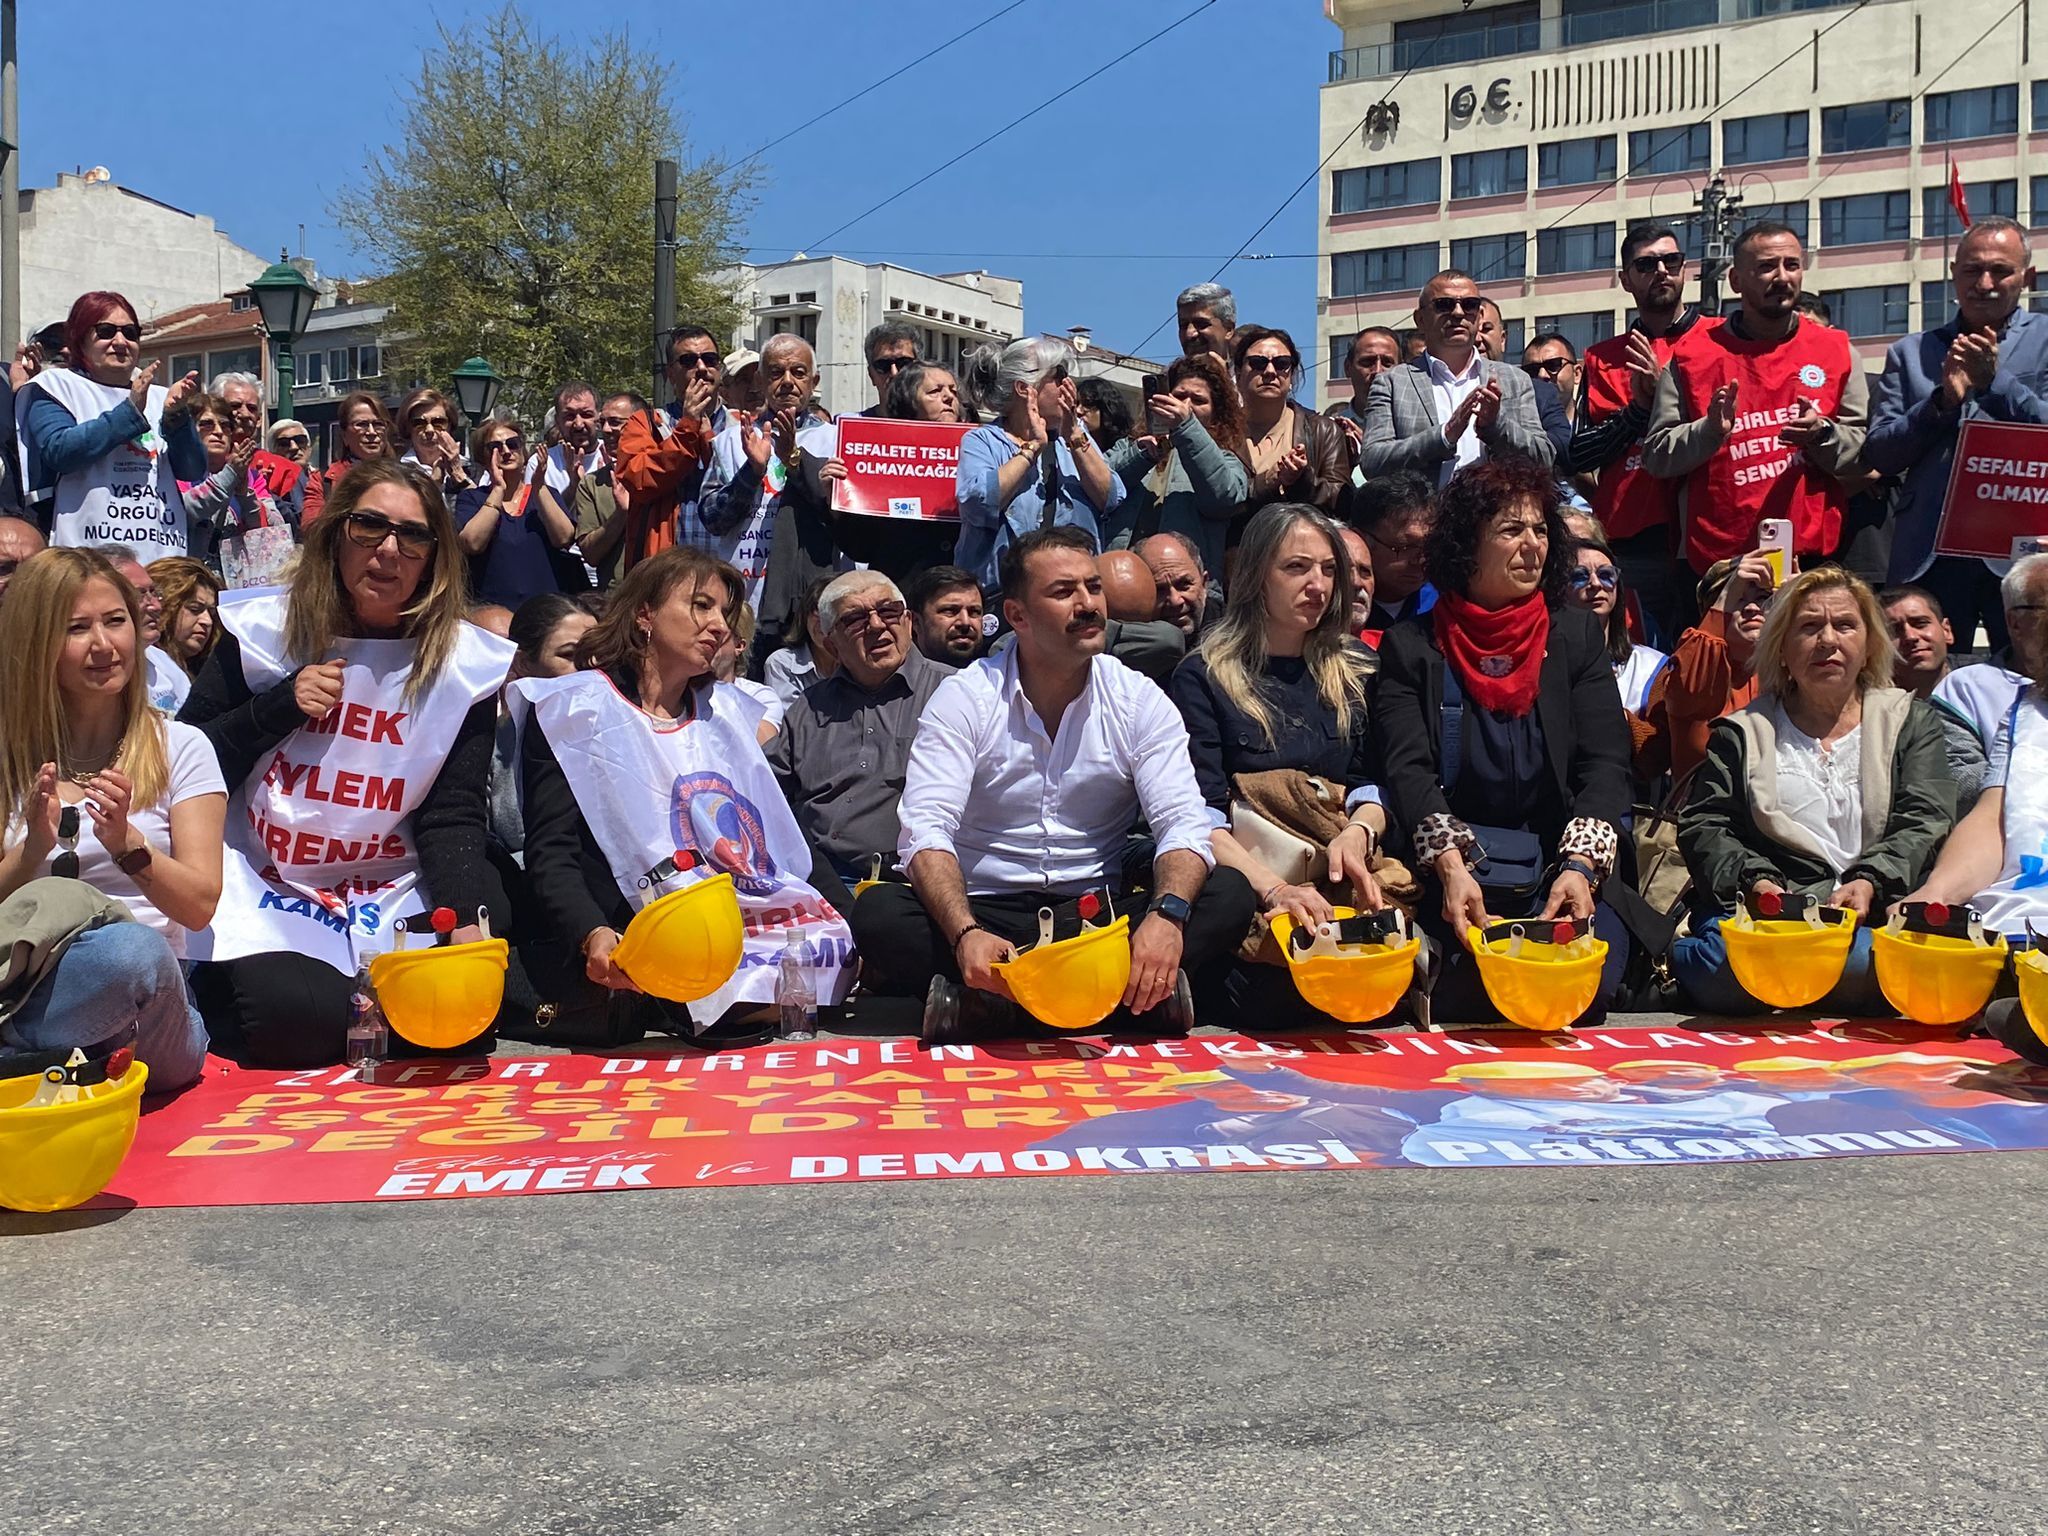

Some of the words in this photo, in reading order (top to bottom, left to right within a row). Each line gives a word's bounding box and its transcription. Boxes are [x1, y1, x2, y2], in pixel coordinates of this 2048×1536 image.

[845, 443, 917, 459] SEFALETE
[920, 446, 959, 460] TESLİ
[1729, 434, 1788, 461] META
[856, 462, 958, 479] OLMAYACAĞIZ
[1733, 451, 1806, 487] SENDİK
[1966, 456, 2048, 479] SEFALET
[1977, 483, 2048, 504] OLMAYA
[306, 702, 408, 745] MEK
[236, 1077, 699, 1108] DORUK
[747, 1061, 1190, 1089] MADEN
[274, 1061, 550, 1087] ZAFER
[201, 1092, 666, 1131] İŞÇİSİ
[711, 1080, 1187, 1108] YALNIZ
[375, 1163, 656, 1197] EMEK
[790, 1139, 1362, 1179] DEMOKRASİ
[1427, 1129, 1963, 1162] Platformu
[394, 1150, 673, 1171] Eskişehir
